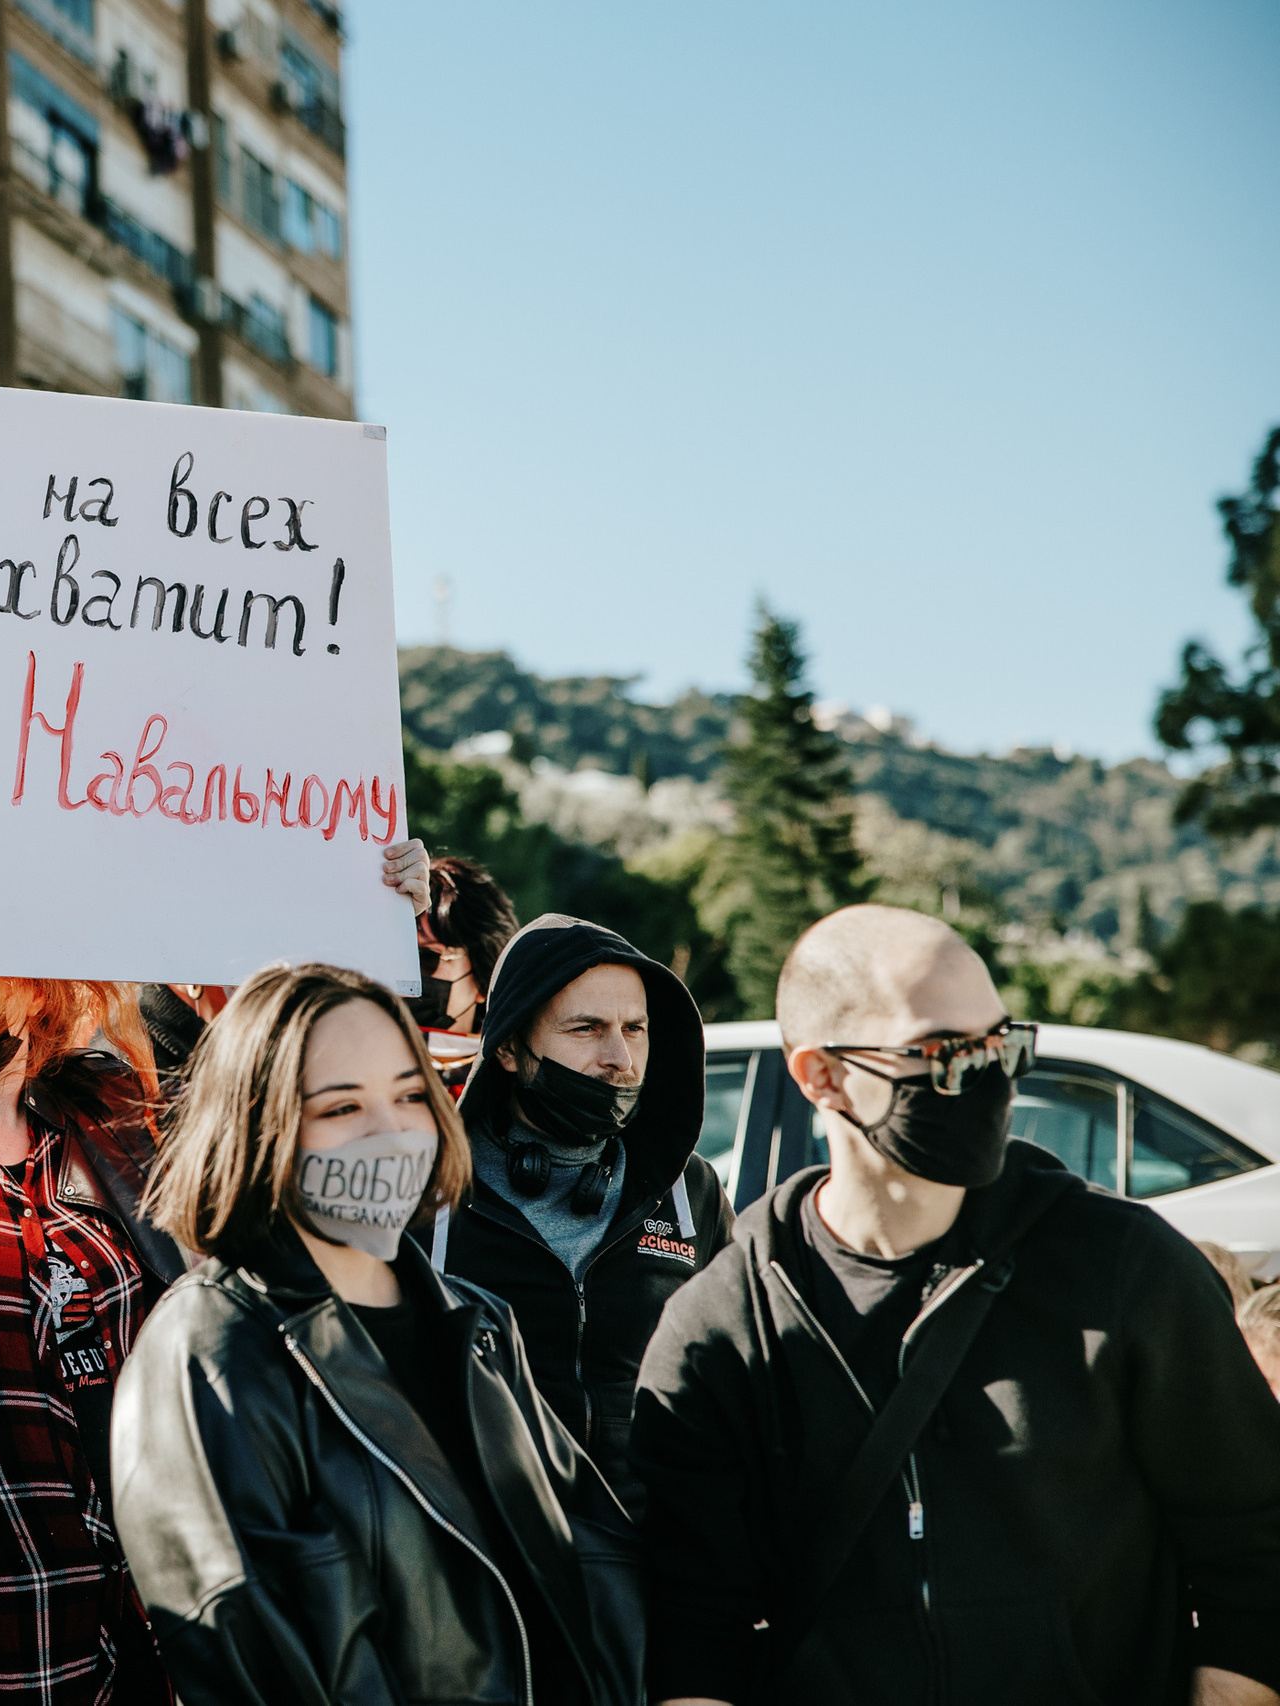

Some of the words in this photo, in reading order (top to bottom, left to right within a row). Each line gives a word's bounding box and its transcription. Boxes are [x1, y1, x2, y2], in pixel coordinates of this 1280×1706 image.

[43, 473, 119, 527] на
[167, 450, 320, 552] всех
[11, 650, 397, 846] Навальному
[638, 1233, 696, 1259] science
